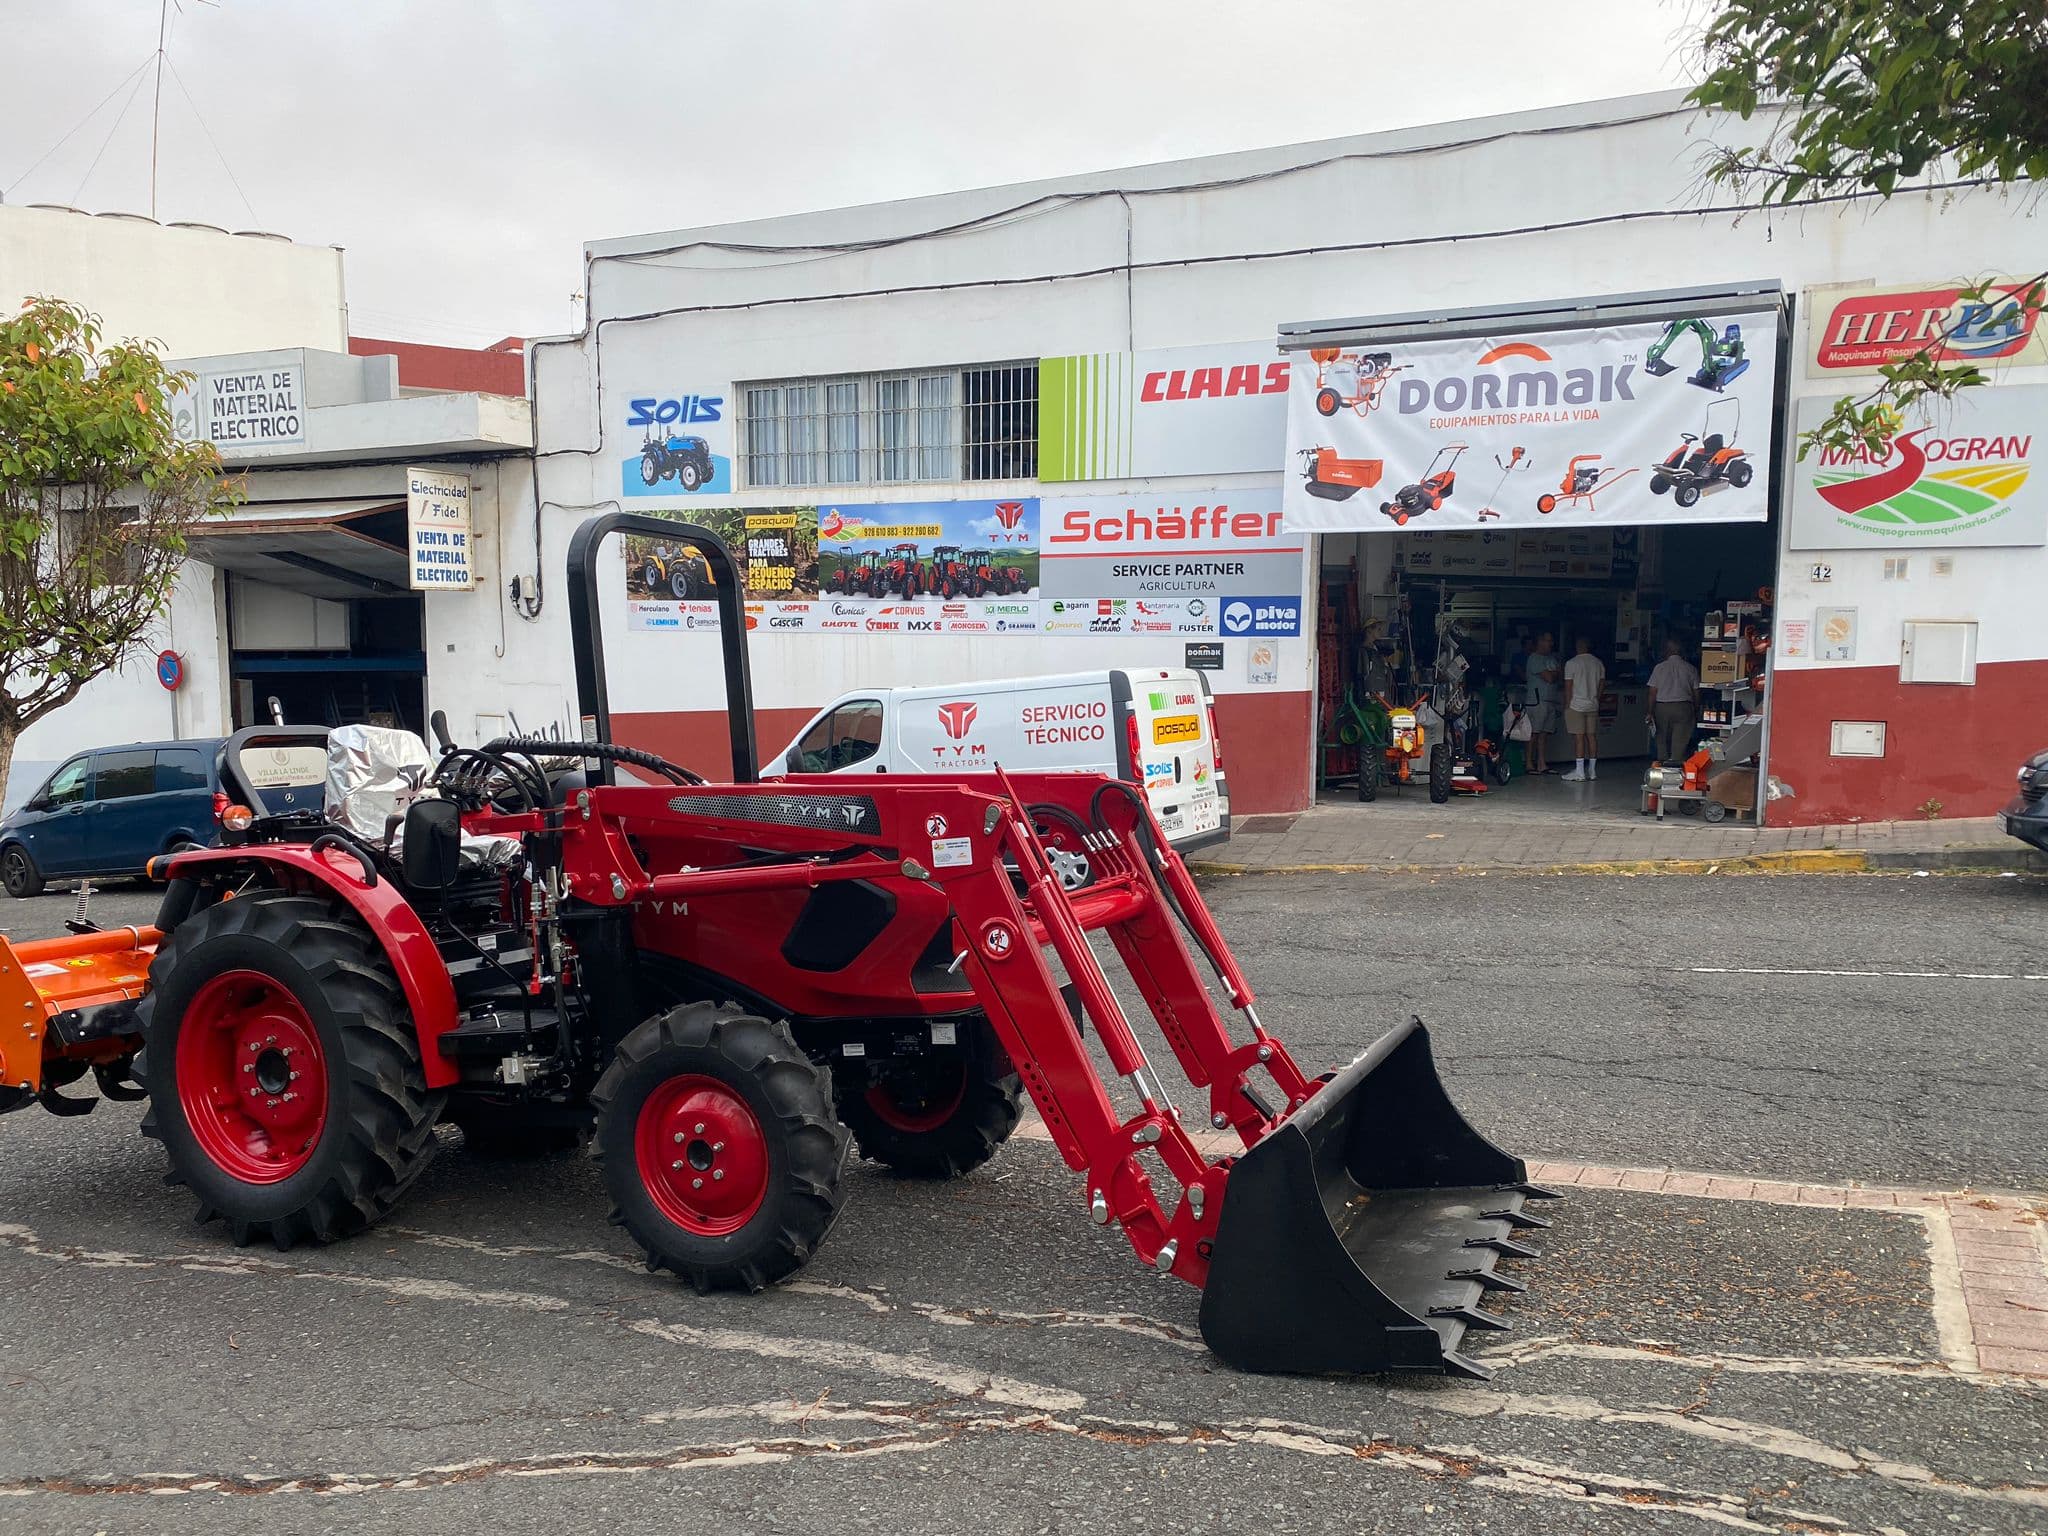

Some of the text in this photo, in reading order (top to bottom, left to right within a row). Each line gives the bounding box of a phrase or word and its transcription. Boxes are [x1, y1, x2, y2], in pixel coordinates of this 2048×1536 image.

[1828, 349, 1881, 363] Maquinaria
[213, 372, 291, 394] VENTA DE
[1140, 362, 1291, 402] CLAAS
[213, 392, 297, 417] MATERIAL
[1429, 409, 1600, 429] EQUIPAMIENTOS PARA LA VIDA
[211, 416, 299, 440] ELECTRICO
[411, 480, 467, 499] Electricidad
[432, 503, 459, 518] Fidel
[1050, 505, 1283, 543] Schäffer
[1837, 505, 2012, 538] www.maqsogranmaquinaria.com
[417, 531, 465, 546] VENTA DE
[903, 527, 914, 536] 922
[989, 534, 1029, 542] TYM
[748, 538, 785, 549] GRANDES
[417, 550, 466, 565] MATERIAL
[748, 548, 788, 557] TRACTORES
[748, 559, 768, 567] PARA
[1113, 563, 1244, 577] SERVICE PARTNER
[416, 568, 468, 583] ELECTRICO
[748, 564, 796, 579] PEQUEÑOS
[1813, 566, 1831, 579] 42
[748, 579, 793, 590] ESPACIOS
[1139, 581, 1216, 591] AGRICULTURA
[895, 607, 926, 615] CORVUS
[1066, 602, 1089, 610] agarin
[1256, 606, 1297, 621] piva
[907, 621, 932, 631] MX
[1256, 621, 1296, 630] motor
[1175, 694, 1195, 705] CLAAS
[1022, 702, 1106, 724] SERVICIO
[1024, 724, 1105, 745] TÉCNICO
[932, 745, 985, 757] TYM
[934, 759, 986, 768] TRACTORS
[779, 803, 831, 819] TYM
[630, 901, 688, 915] TYM
